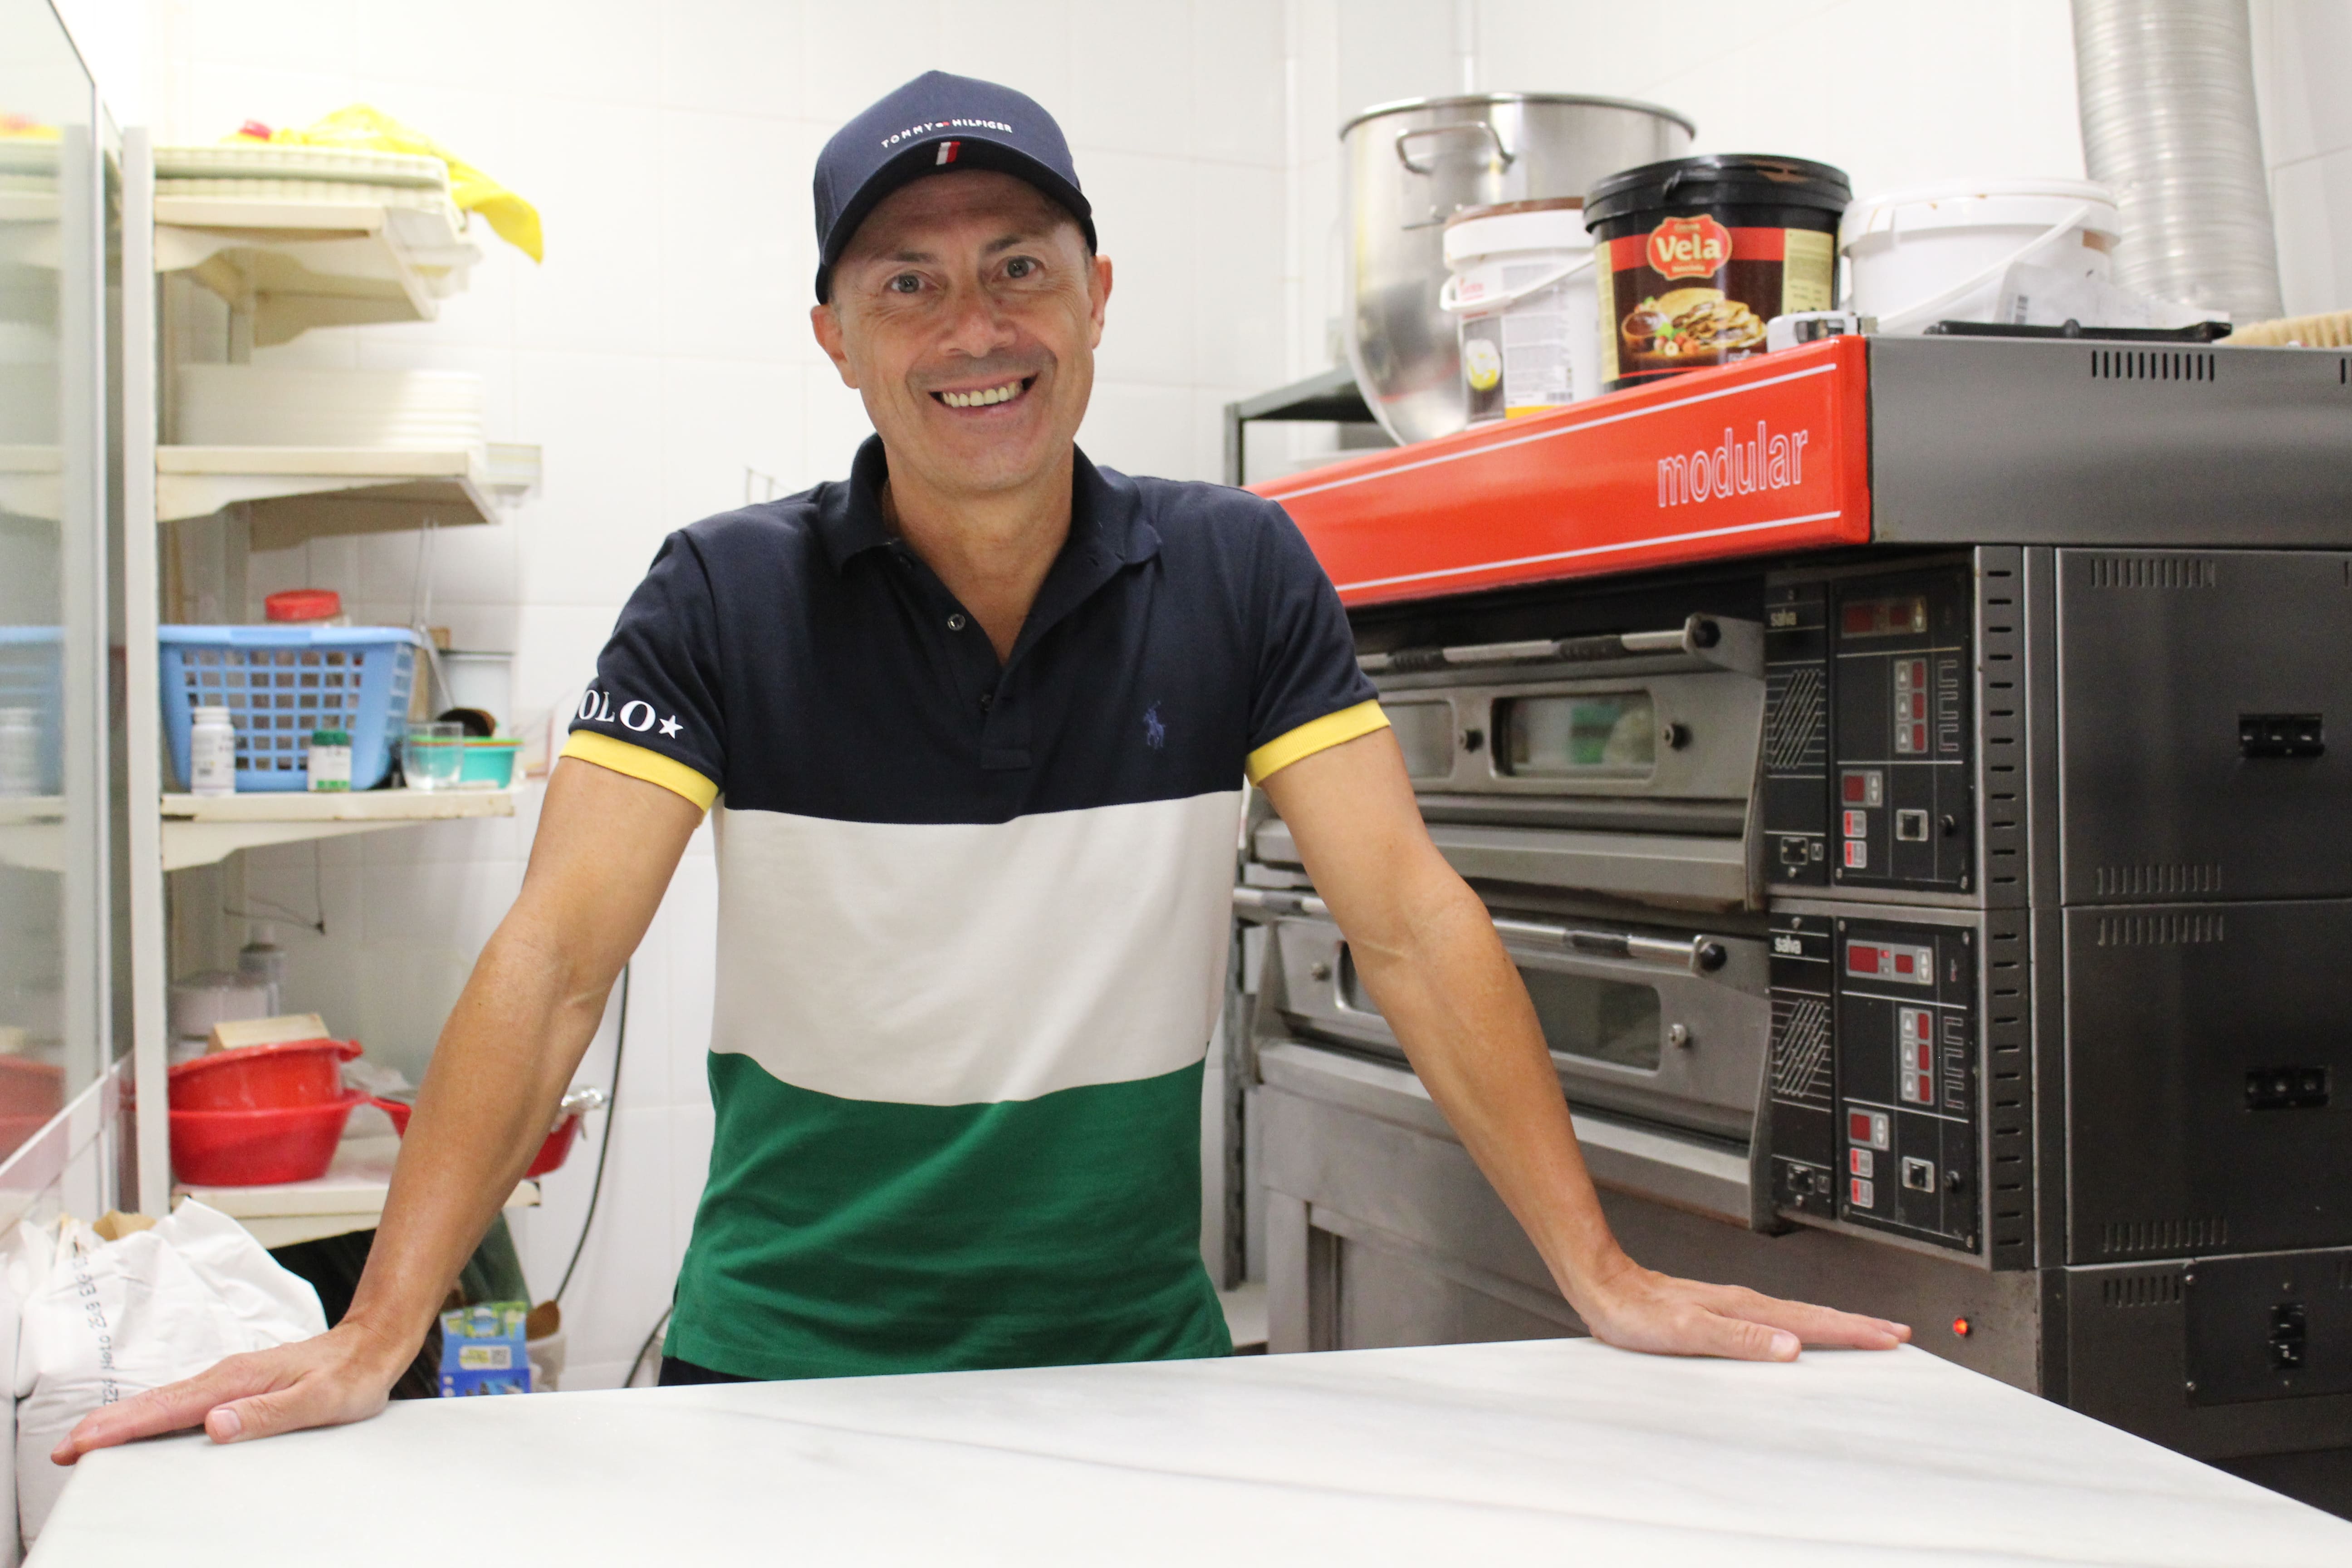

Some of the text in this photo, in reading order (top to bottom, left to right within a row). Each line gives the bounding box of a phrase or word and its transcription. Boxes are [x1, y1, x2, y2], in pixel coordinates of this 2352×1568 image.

[881, 118, 1013, 148] TOMMY HILFIGER
[1656, 233, 1722, 263] Vela
[1657, 420, 1808, 508] modular
